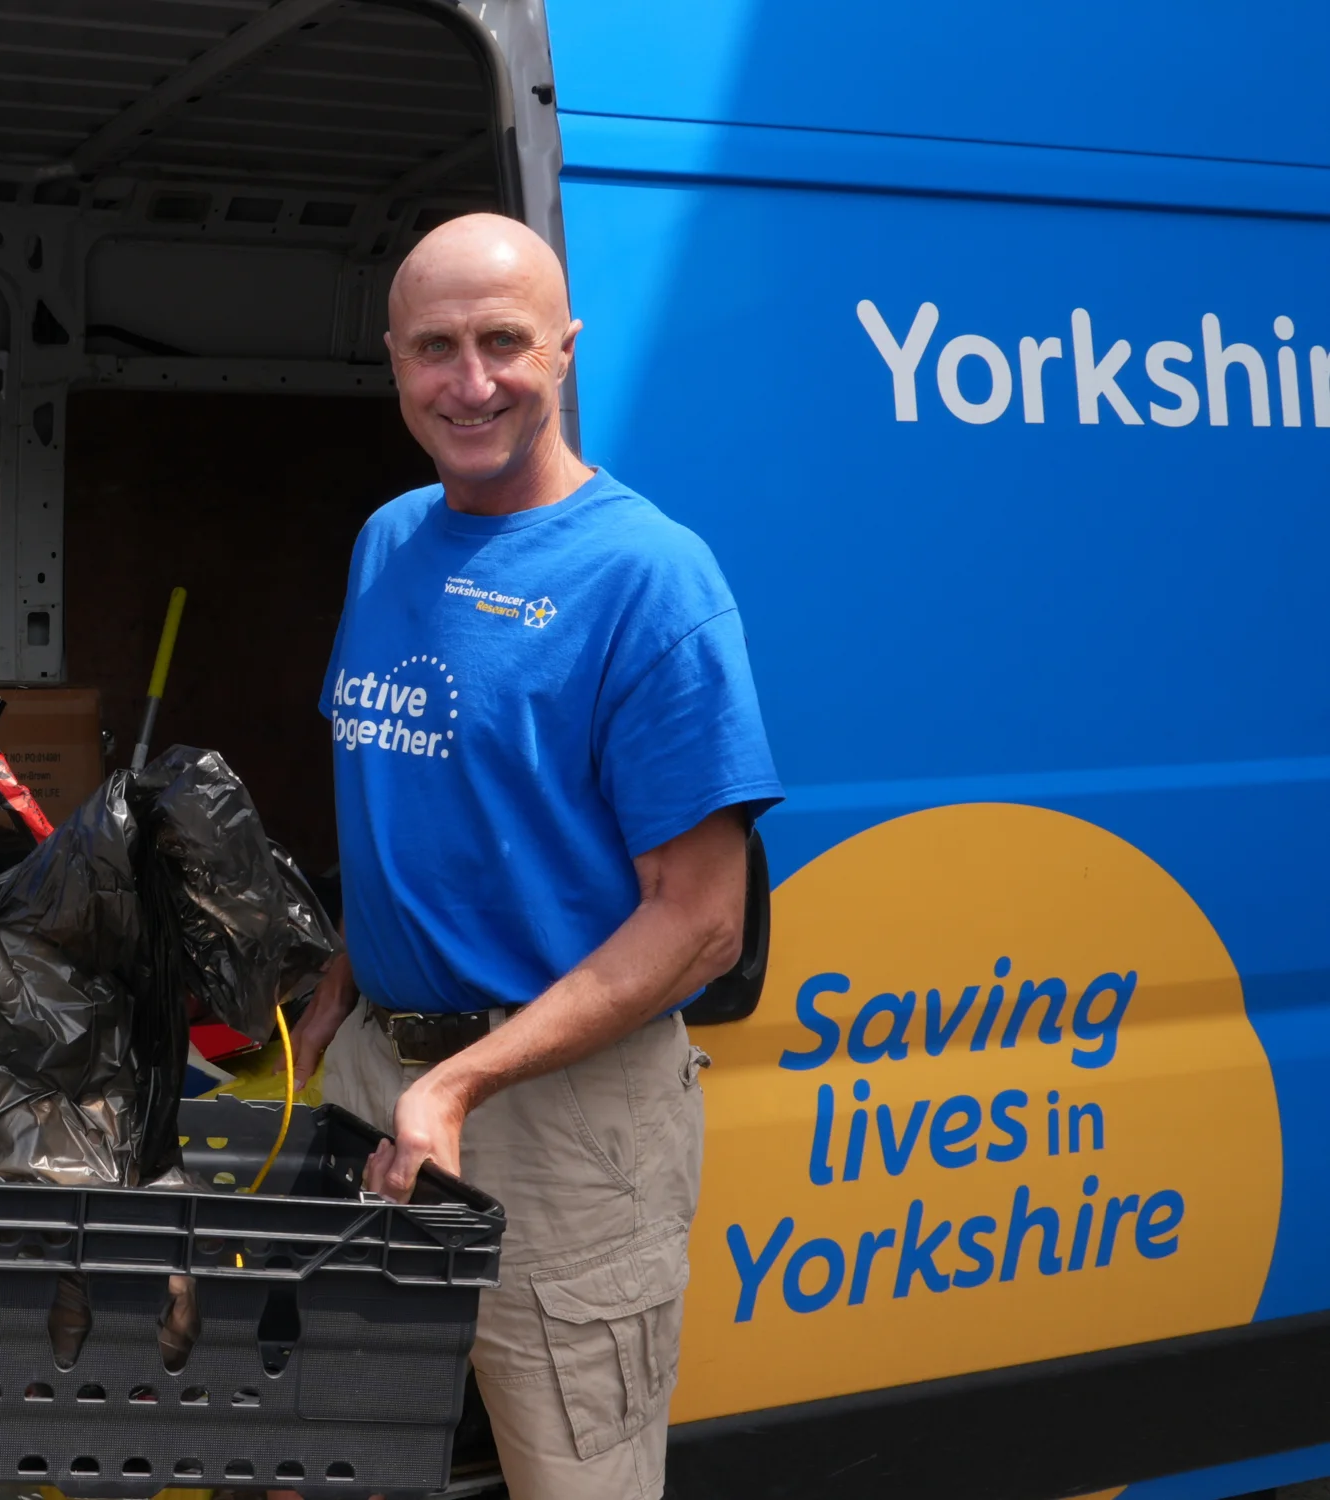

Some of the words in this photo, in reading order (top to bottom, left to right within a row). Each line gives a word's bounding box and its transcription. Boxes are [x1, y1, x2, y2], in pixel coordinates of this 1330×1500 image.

[444, 583, 488, 599] Yorkshire
[489, 591, 525, 606] Cancer
[447, 576, 466, 584] Funded
[476, 601, 520, 618] Research
[333, 668, 427, 717] Active
[779, 956, 1137, 1071] Saving
[809, 1079, 1028, 1186] lives
[1047, 1090, 1104, 1156] in
[727, 1175, 1185, 1323] Yorkshire
